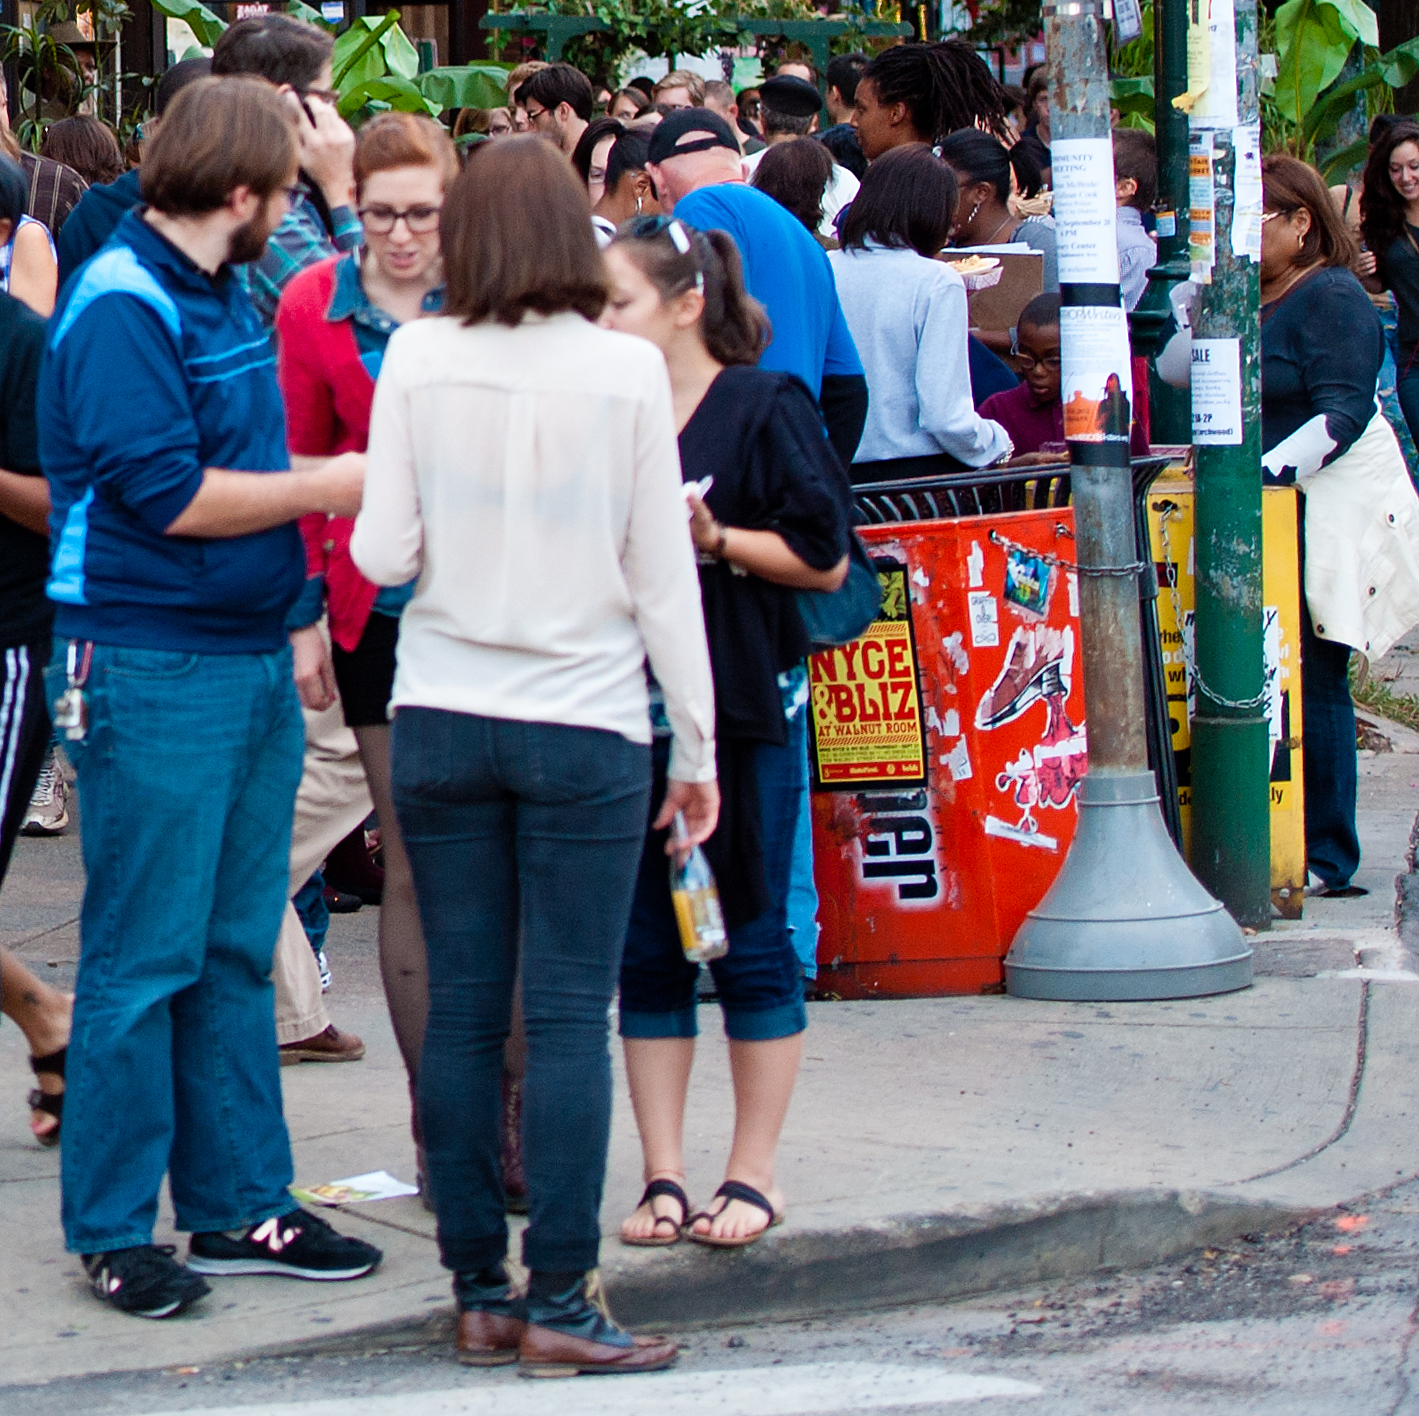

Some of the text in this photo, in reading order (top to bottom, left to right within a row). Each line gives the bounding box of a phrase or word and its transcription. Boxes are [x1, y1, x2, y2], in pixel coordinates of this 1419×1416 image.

[812, 638, 911, 683] NYCE
[819, 721, 918, 737] AT WALNUT ROOM
